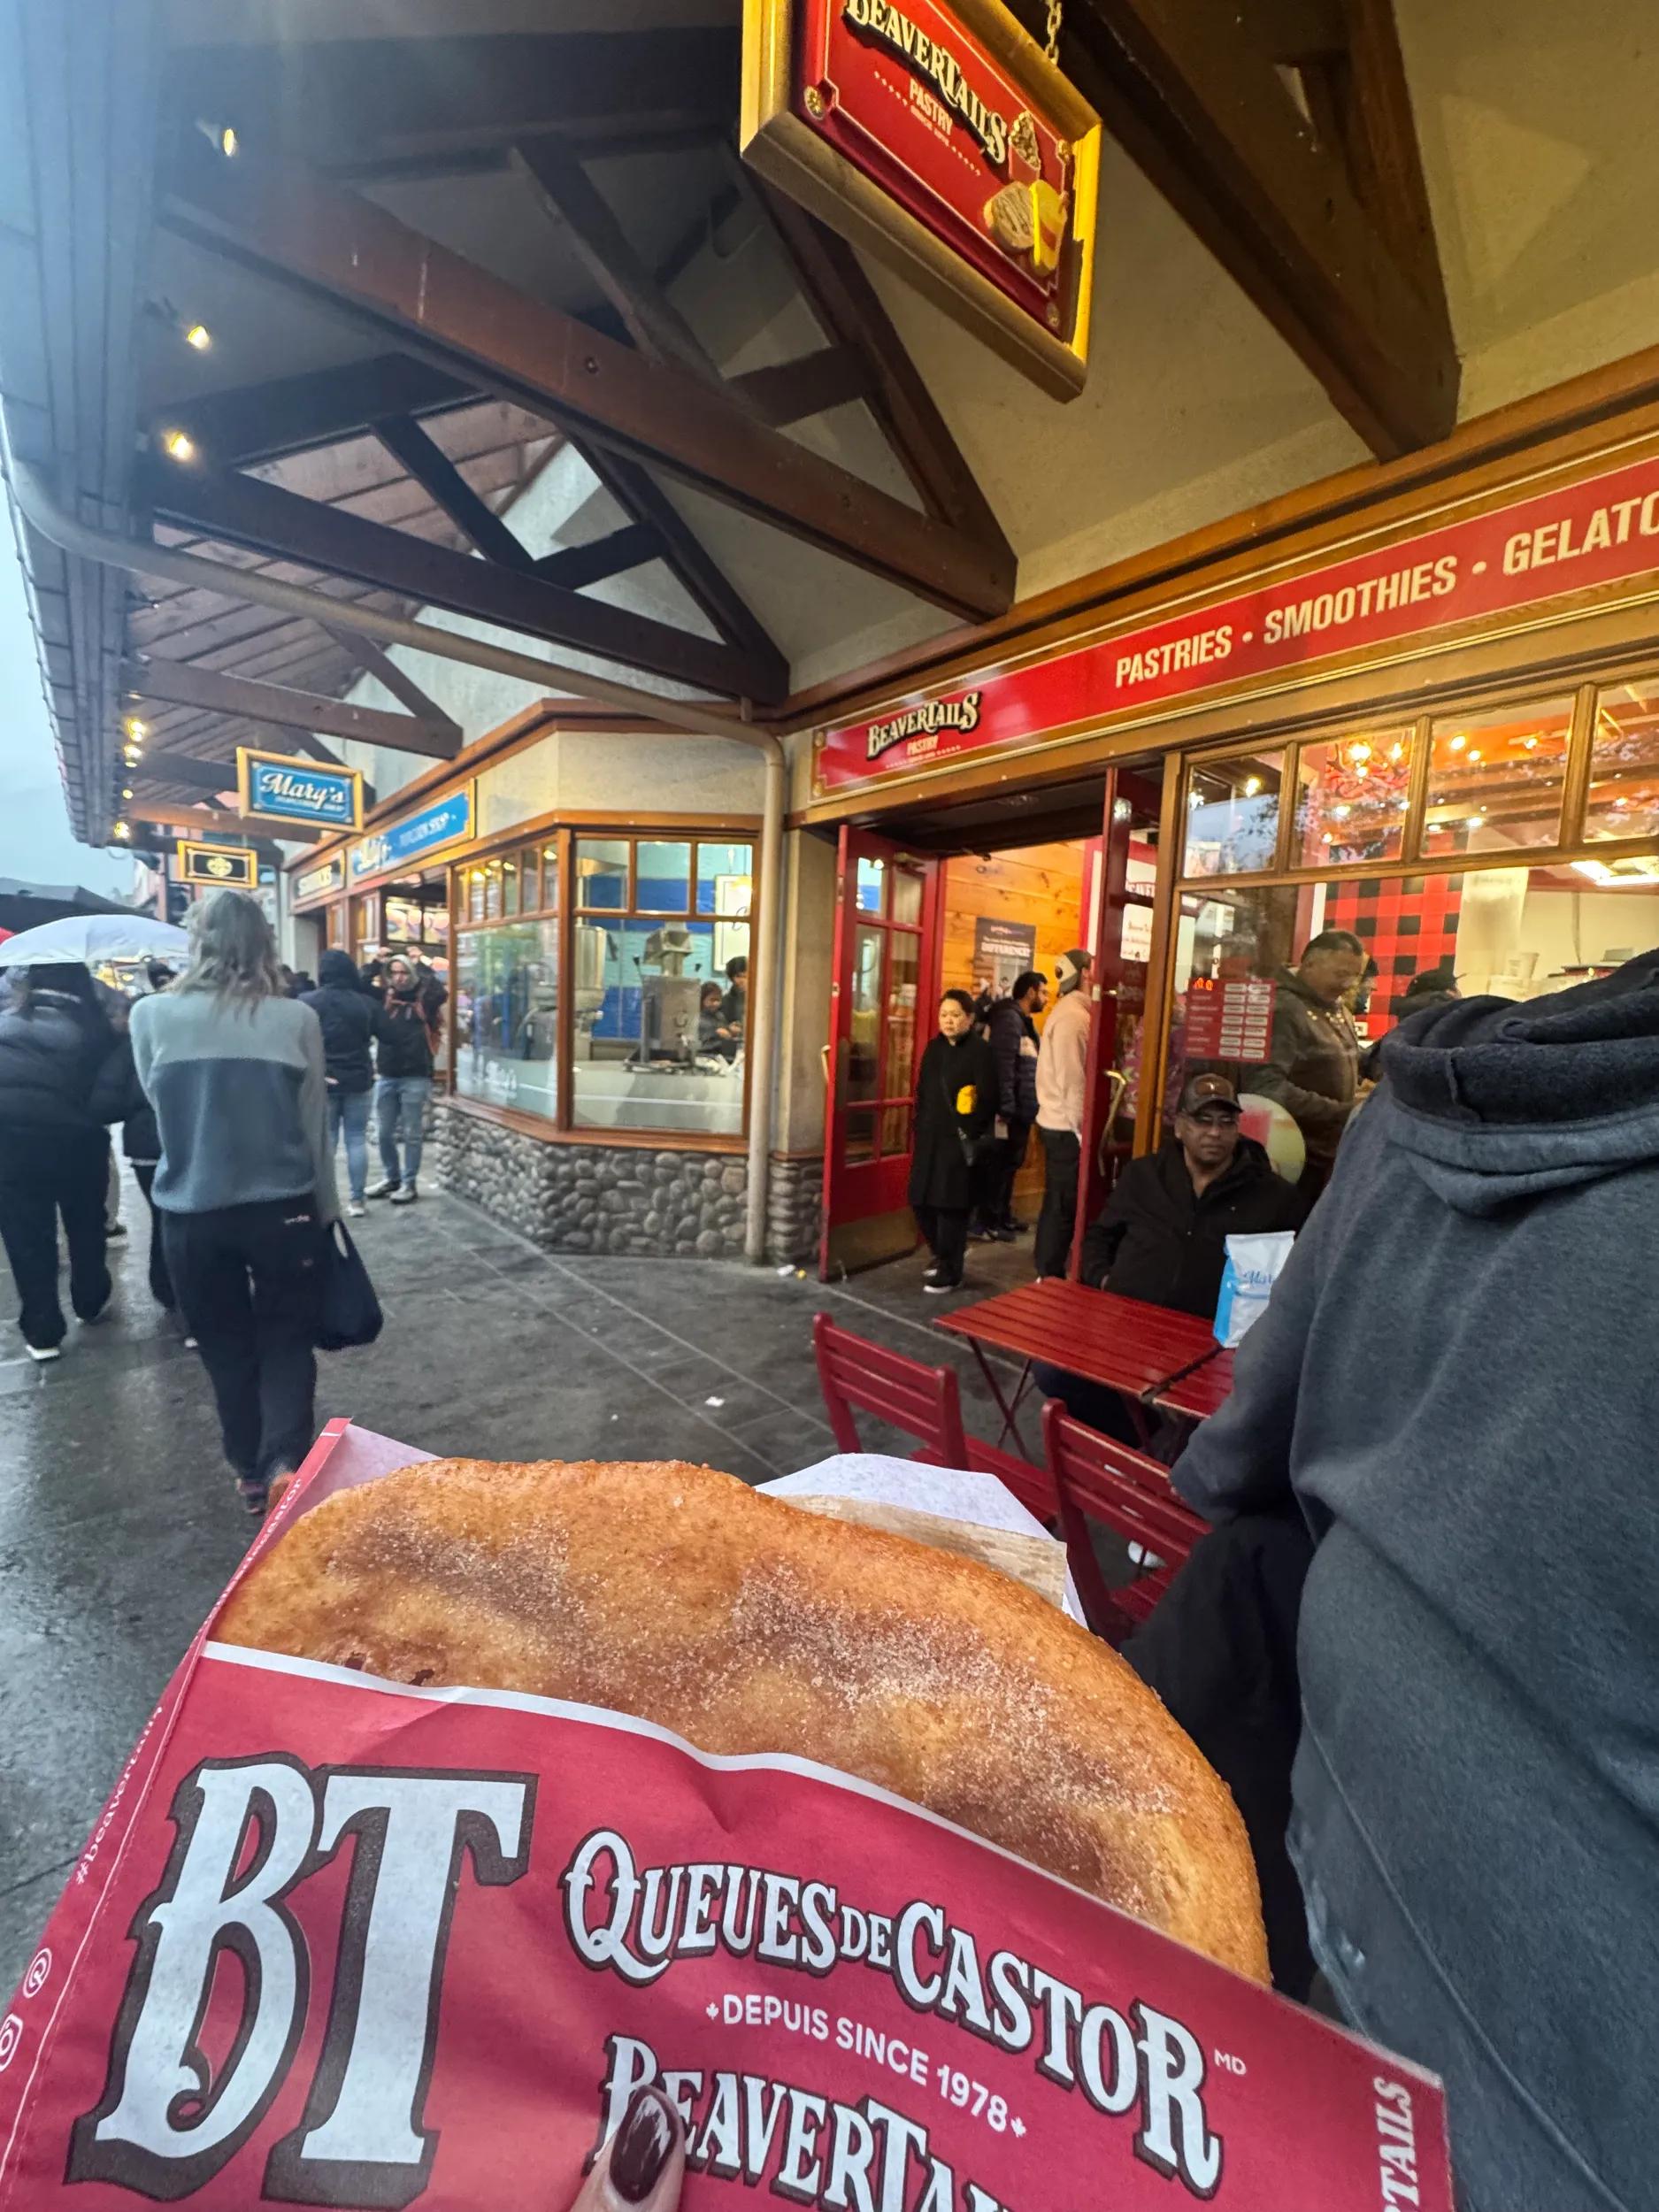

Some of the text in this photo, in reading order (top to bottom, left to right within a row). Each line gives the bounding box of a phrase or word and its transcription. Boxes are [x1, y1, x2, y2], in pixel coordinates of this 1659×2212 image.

[909, 78, 954, 136] PASTRY
[1115, 490, 1659, 688] PASTRIES SMOOTHIES GELATO
[259, 772, 345, 810] Mary's
[867, 691, 979, 759] BEAVERTAILS
[66, 1752, 537, 2200] BT
[561, 1828, 1223, 2198] QUEUES DE CASTOR
[591, 2034, 1010, 2212] BEAVERTA
[723, 1993, 1008, 2133] DEPUIS SINCE 1978
[1213, 2047, 1248, 2077] MD
[1373, 2075, 1421, 2212] TAILS
